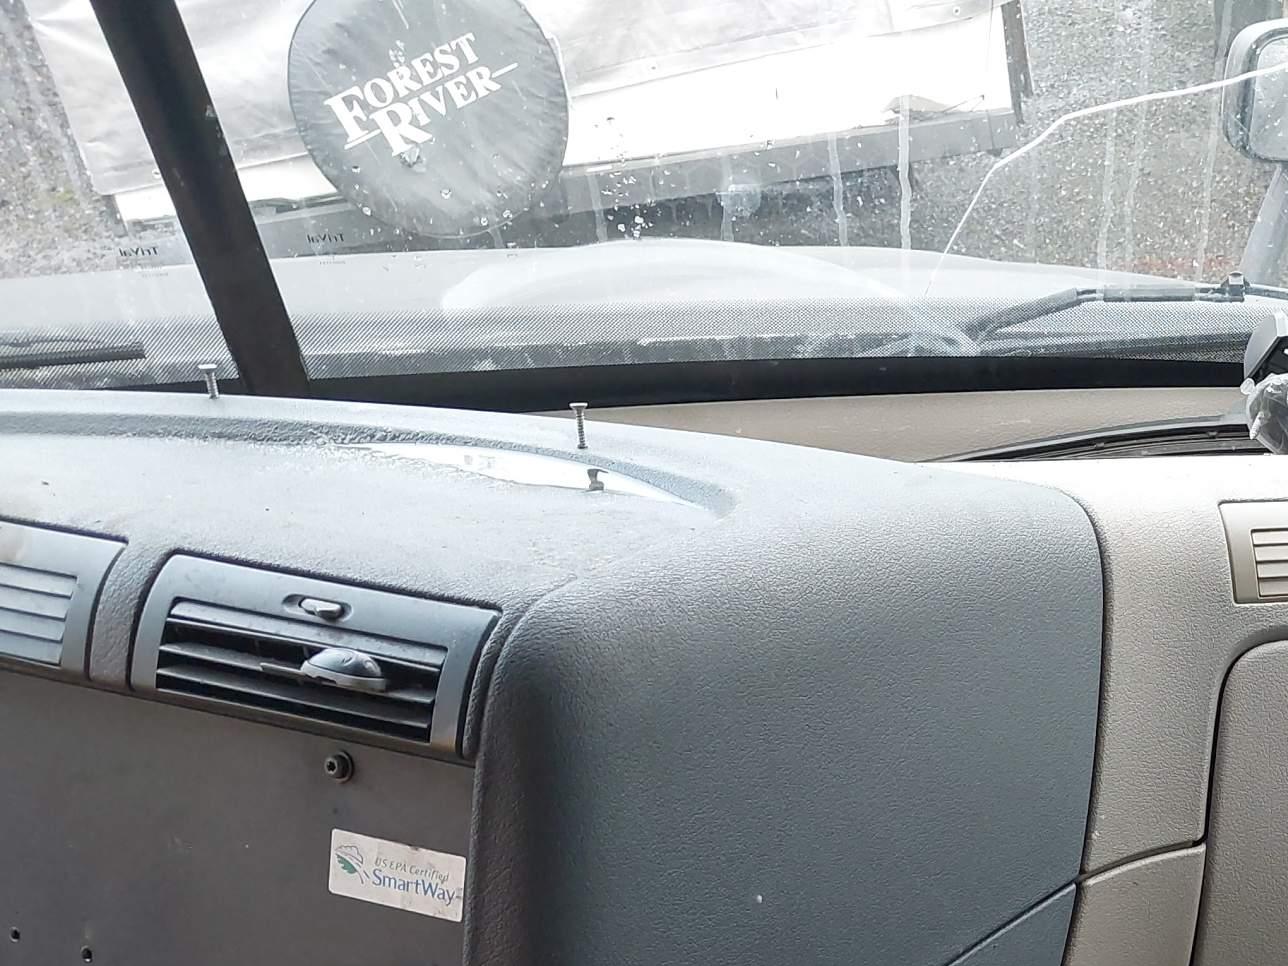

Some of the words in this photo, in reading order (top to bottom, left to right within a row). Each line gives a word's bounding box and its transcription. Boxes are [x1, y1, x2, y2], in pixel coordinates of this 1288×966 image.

[323, 32, 479, 142] FOREST
[369, 66, 502, 157] RIVER
[372, 868, 456, 907] SmartWay
[375, 857, 387, 868] US
[389, 861, 407, 873] EPA
[409, 865, 449, 884] Certified
